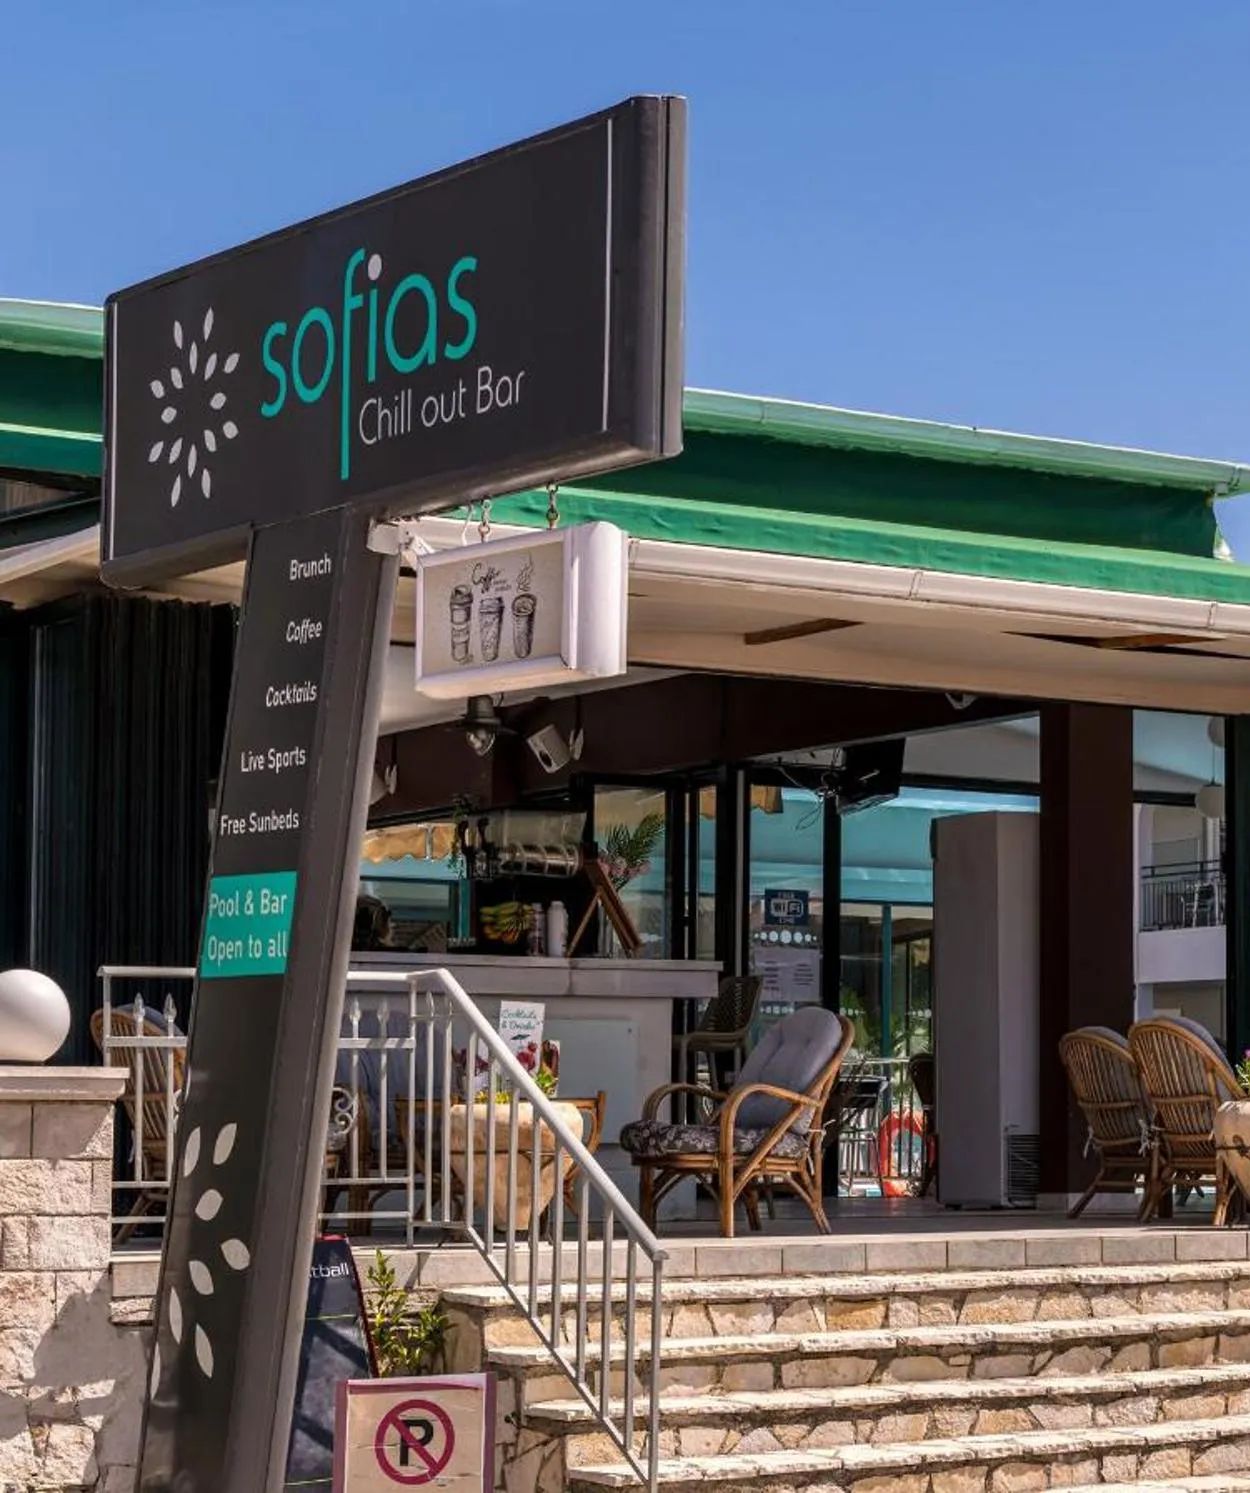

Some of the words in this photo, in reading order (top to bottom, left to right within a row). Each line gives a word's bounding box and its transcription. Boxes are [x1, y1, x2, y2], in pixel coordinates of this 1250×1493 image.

[261, 248, 477, 480] sofias
[359, 387, 412, 446] Chill
[421, 378, 467, 428] out
[476, 365, 526, 414] Bar
[290, 553, 331, 580] Brunch
[286, 619, 323, 644] Coffee
[266, 681, 317, 707] Cocktails
[241, 752, 264, 773] Live
[268, 747, 306, 774] Sports
[220, 814, 246, 836] Free
[249, 808, 299, 833] Sunbeds
[209, 890, 239, 918] Pool
[244, 889, 254, 916] &
[261, 888, 288, 915] Bar
[208, 935, 243, 968] Open
[249, 934, 262, 958] to
[267, 931, 287, 957] all
